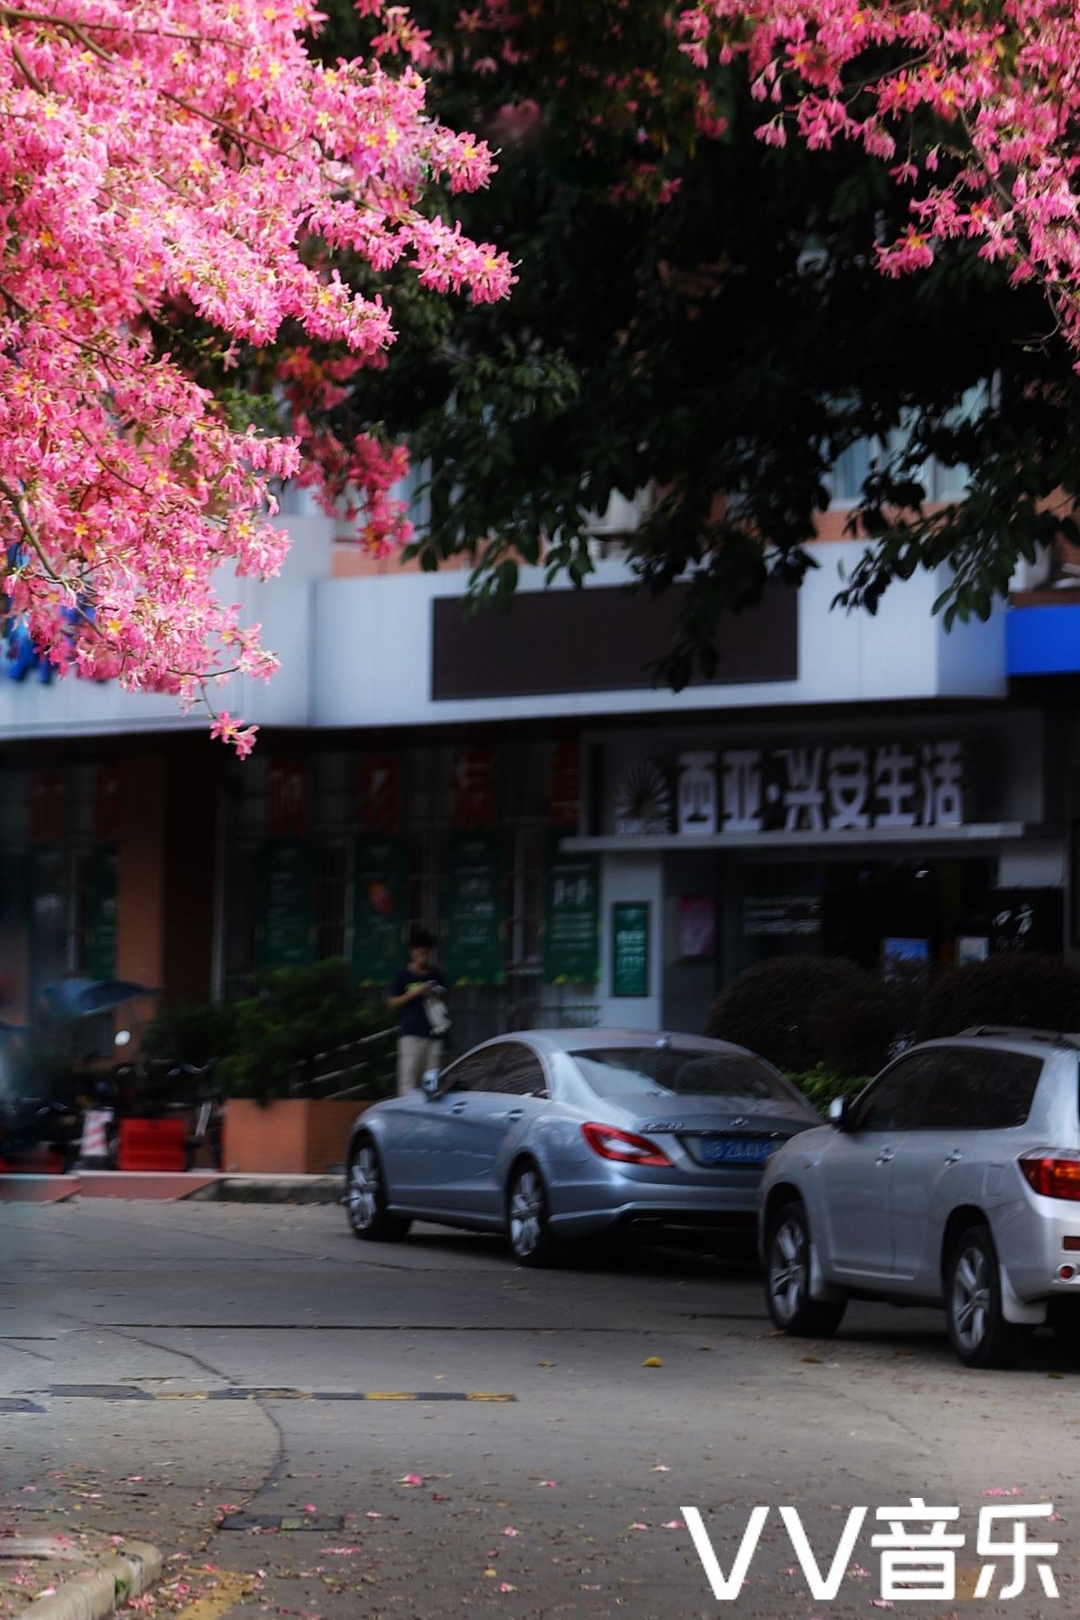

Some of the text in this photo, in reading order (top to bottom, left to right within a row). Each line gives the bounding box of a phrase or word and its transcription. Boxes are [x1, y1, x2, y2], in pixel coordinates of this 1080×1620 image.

[677, 741, 964, 834] 西亚·兴安生活
